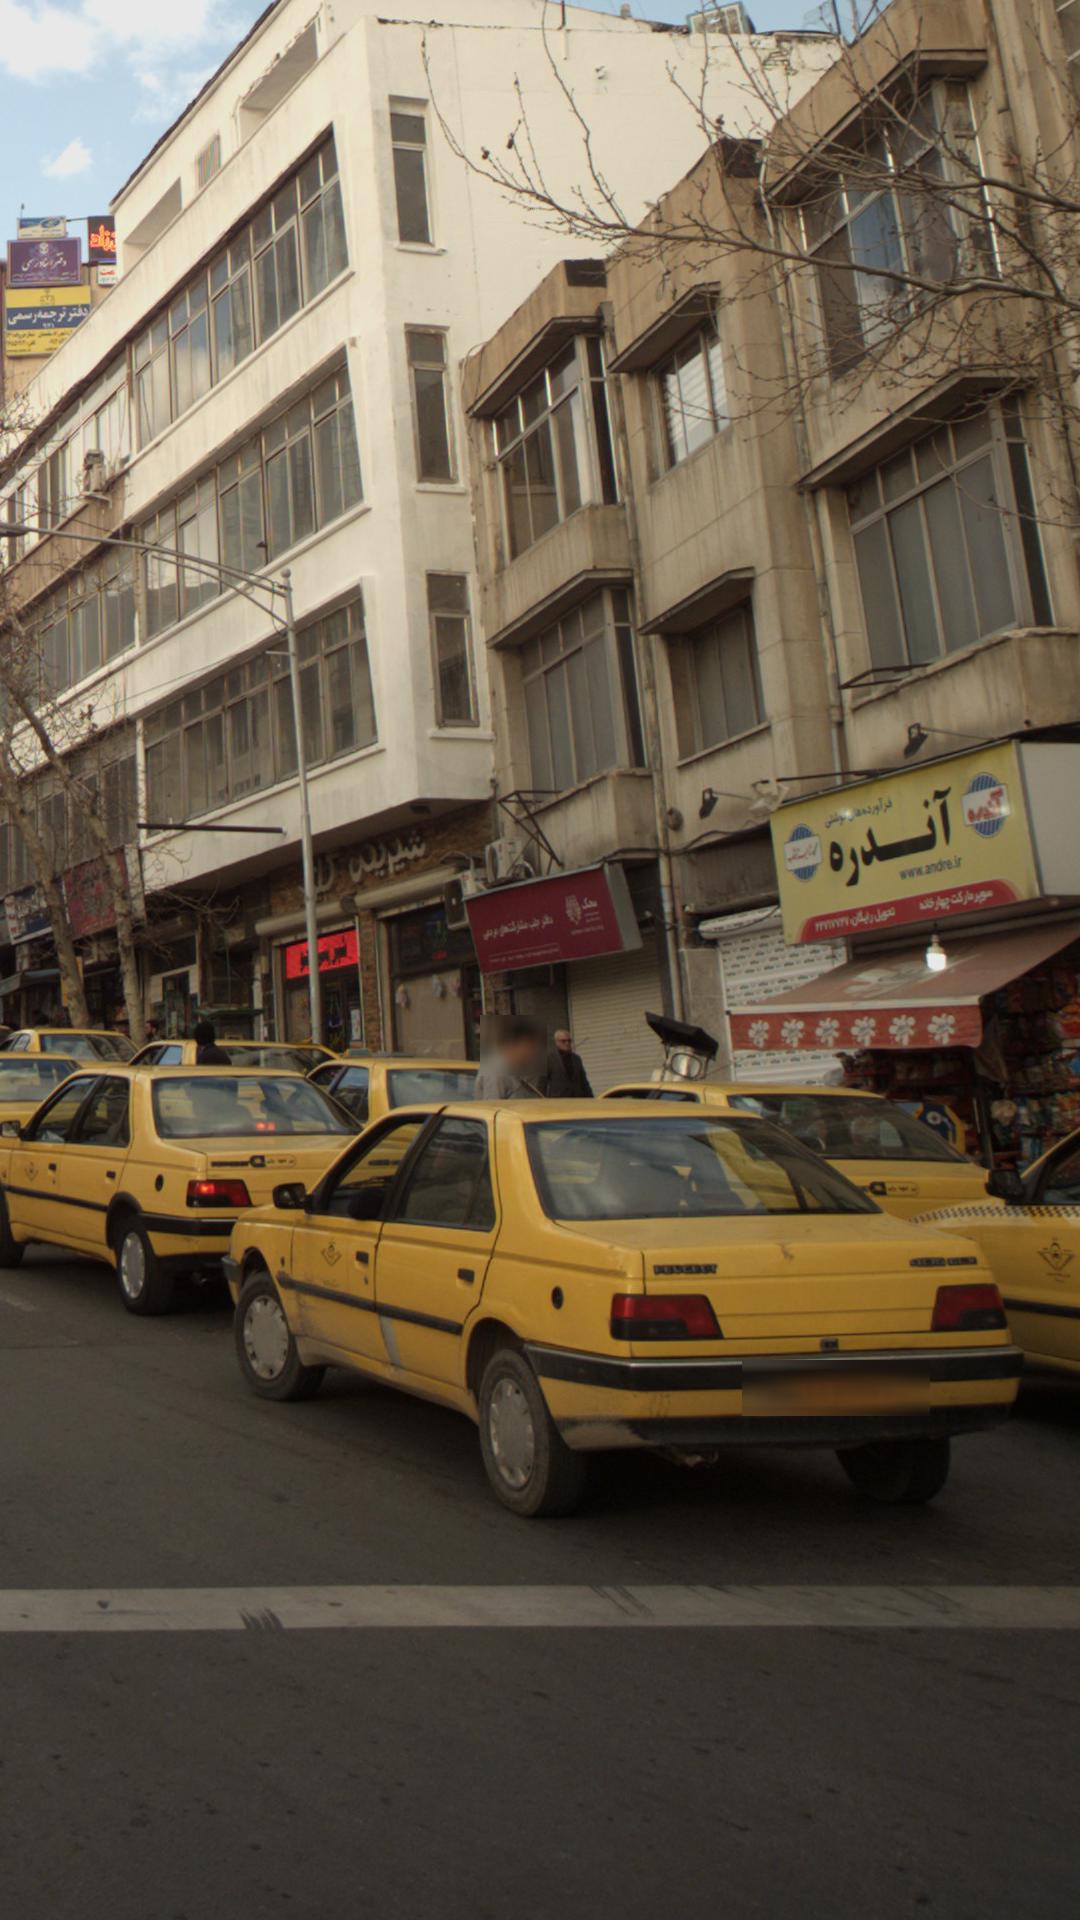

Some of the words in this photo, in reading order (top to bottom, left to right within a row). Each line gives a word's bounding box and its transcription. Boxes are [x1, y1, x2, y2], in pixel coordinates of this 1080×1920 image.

[7, 312, 38, 325] رسمی
[38, 306, 67, 322] ترجمه
[829, 786, 951, 887] آندره
